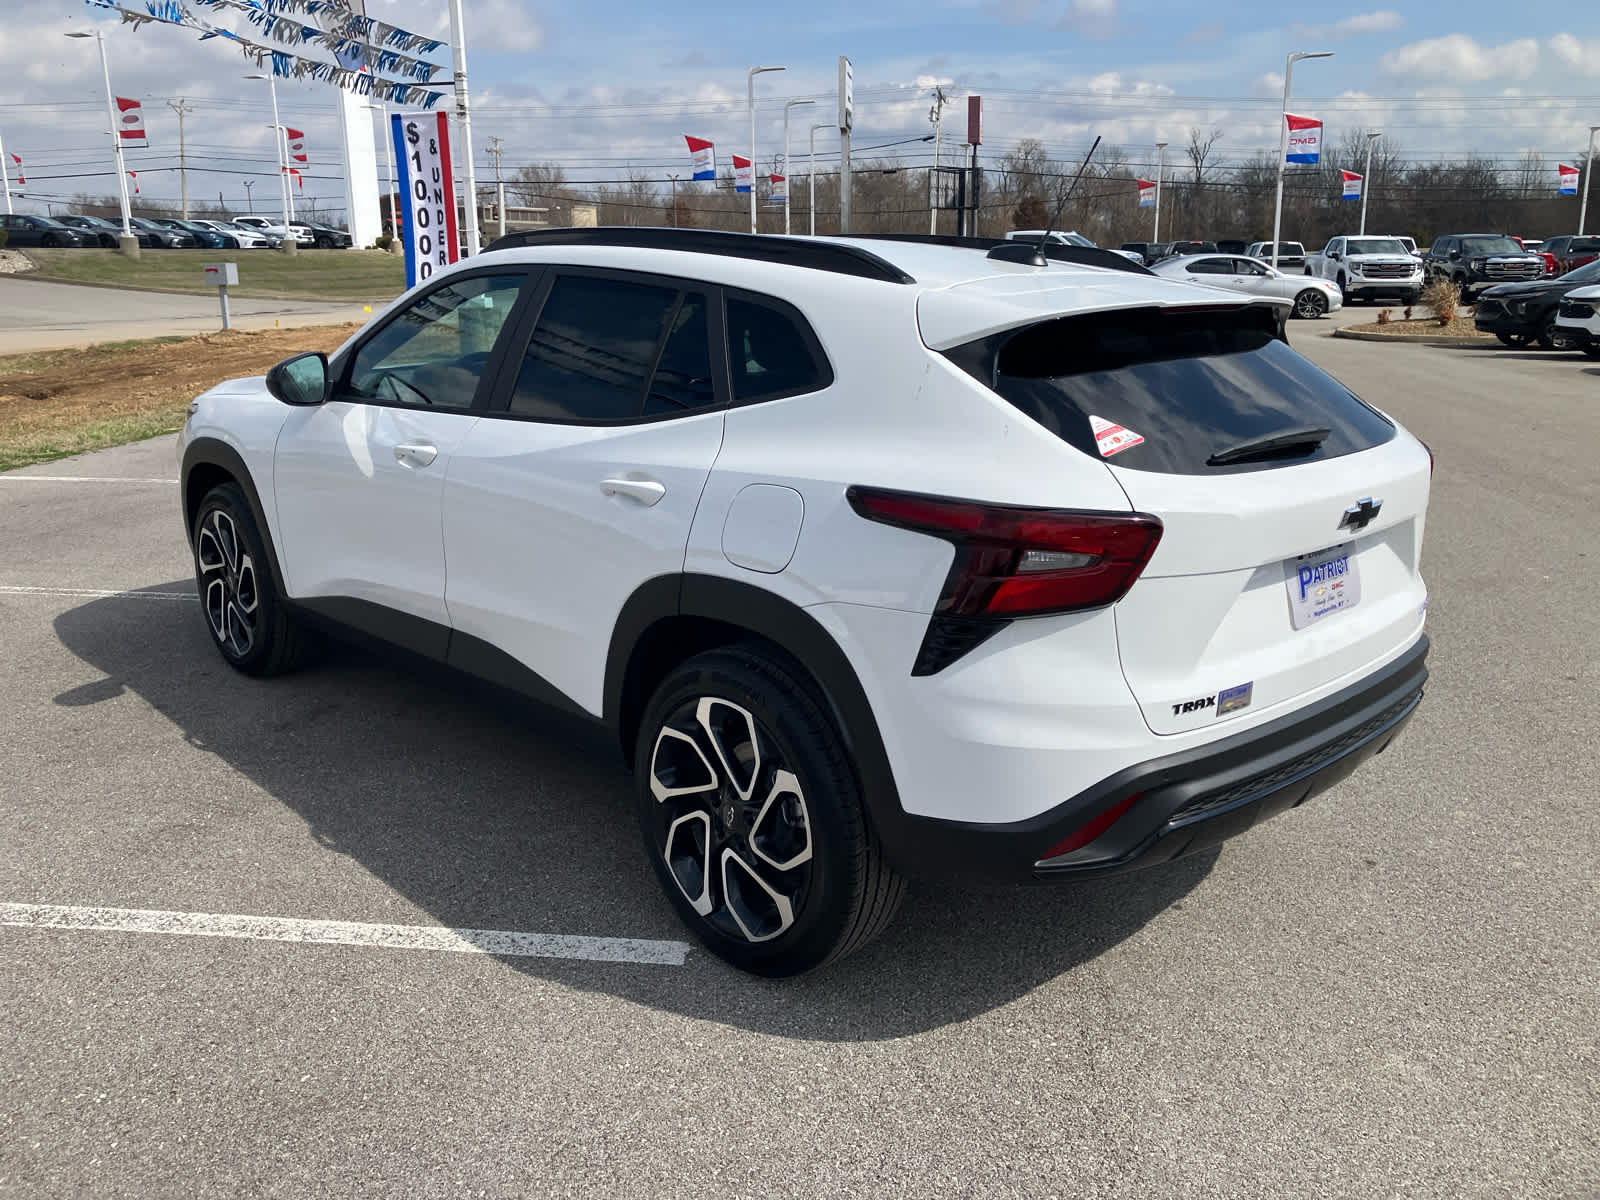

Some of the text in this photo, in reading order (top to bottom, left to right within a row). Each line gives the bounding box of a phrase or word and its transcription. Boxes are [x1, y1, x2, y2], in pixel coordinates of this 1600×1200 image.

[429, 138, 447, 266] & UNDER
[1298, 556, 1349, 601] PATRIOT
[1171, 695, 1216, 716] TRAX
